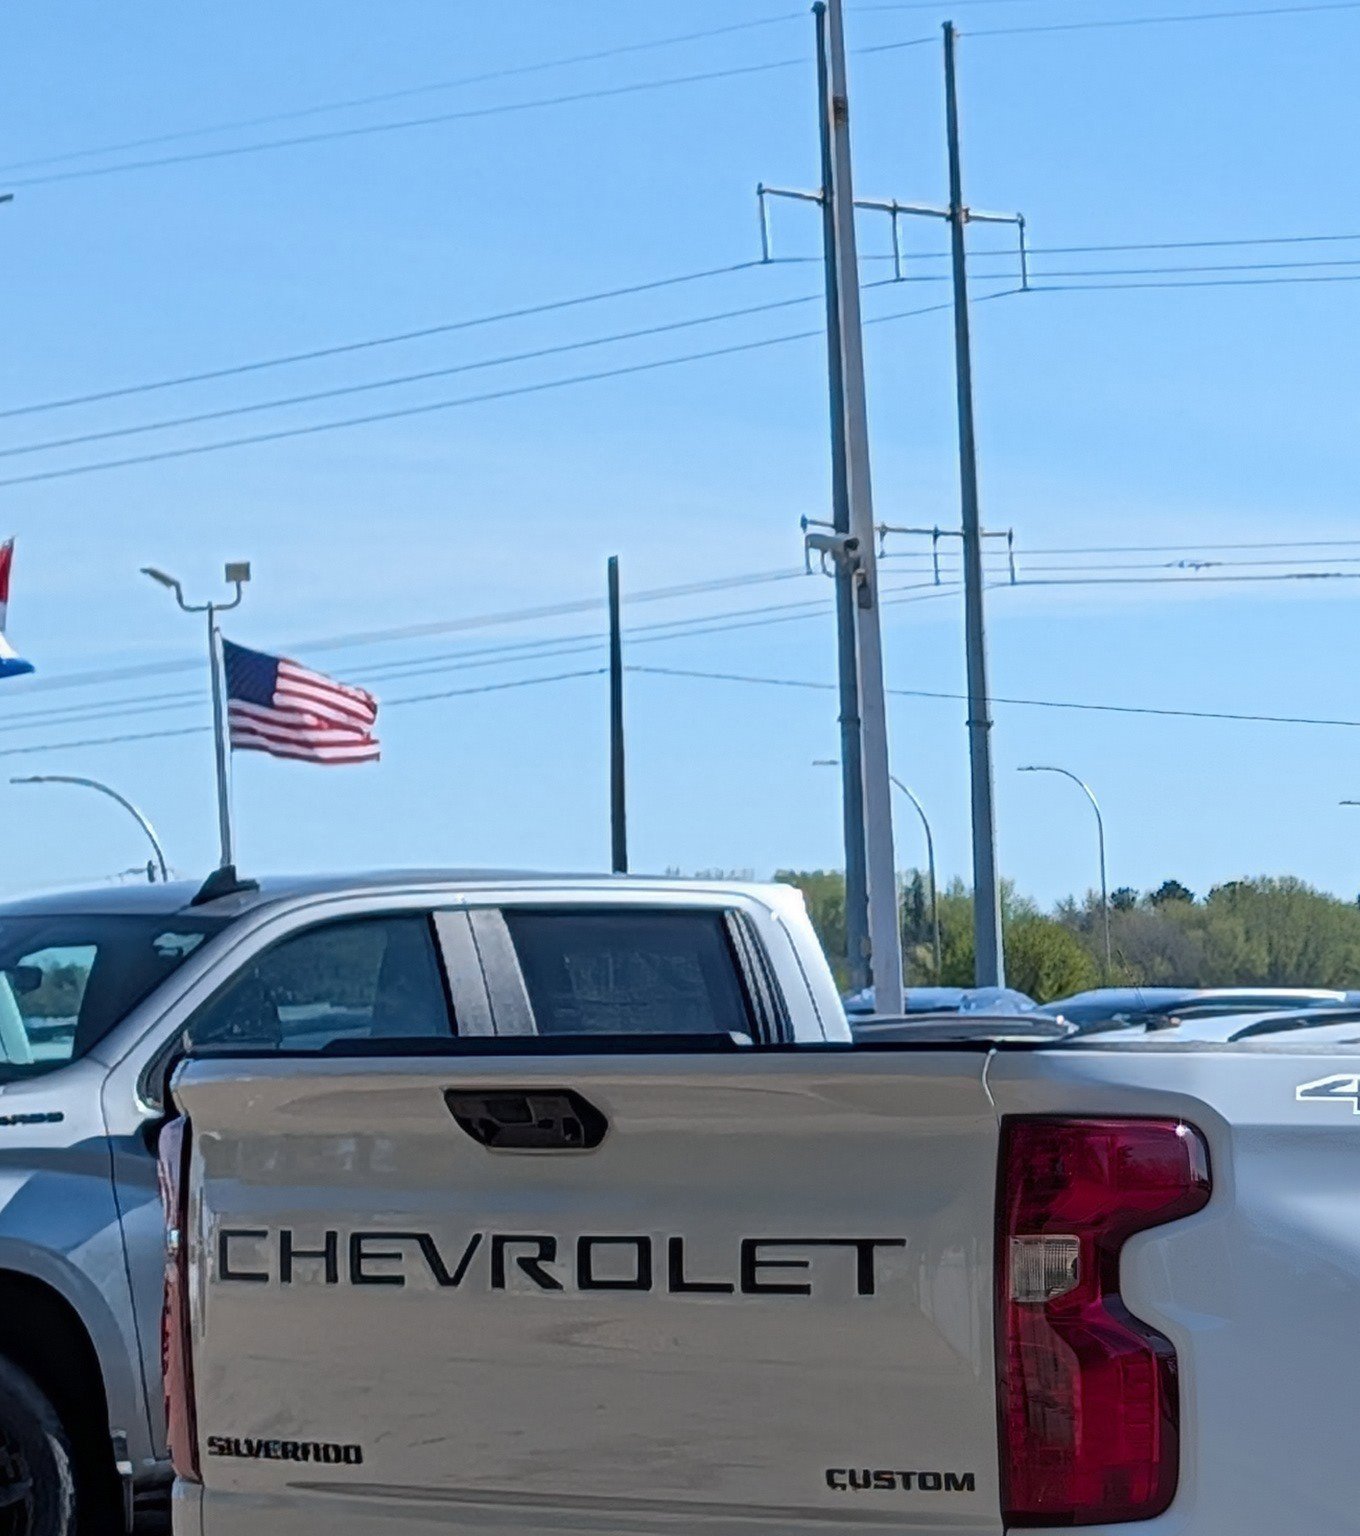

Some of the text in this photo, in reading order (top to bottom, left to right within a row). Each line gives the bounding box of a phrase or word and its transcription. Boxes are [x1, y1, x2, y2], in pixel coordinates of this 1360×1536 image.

[219, 1229, 907, 1295] CHEVROLET
[206, 1435, 363, 1464] SILVERADO
[825, 1468, 975, 1492] CUSTOM
